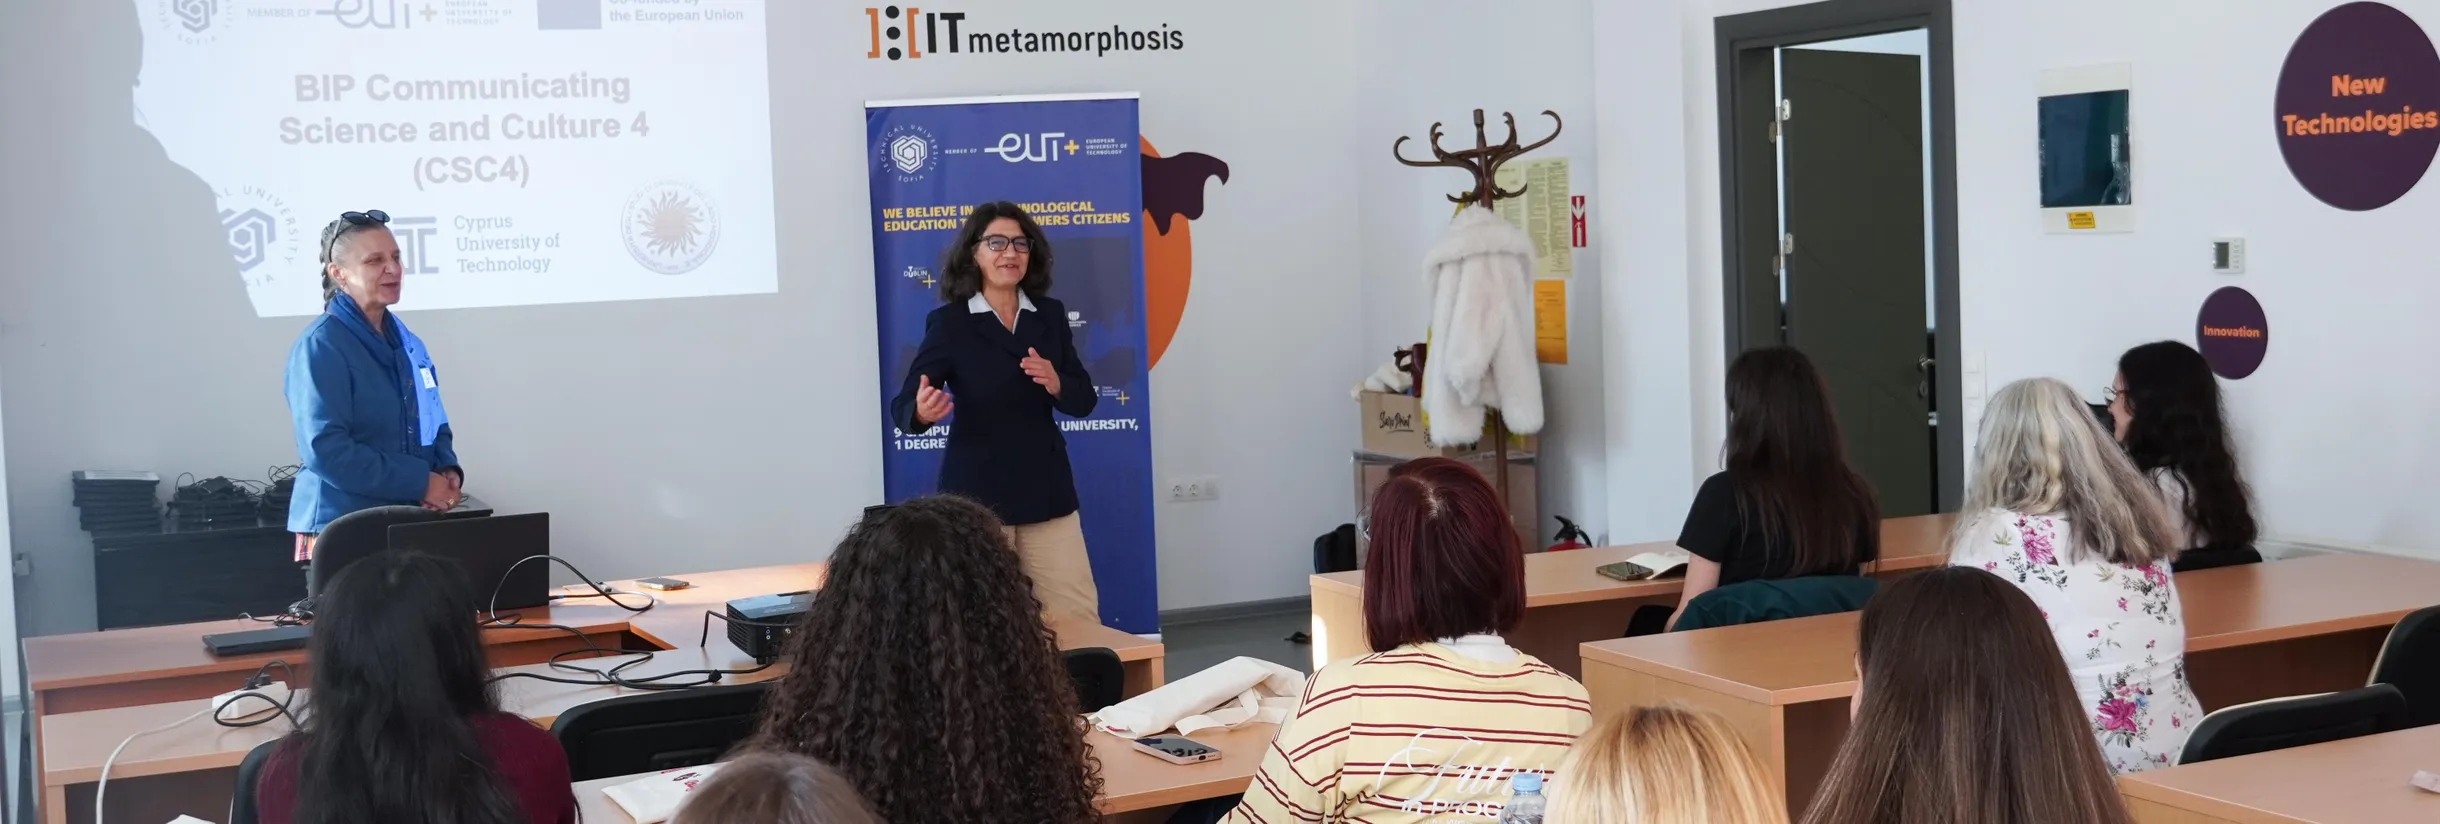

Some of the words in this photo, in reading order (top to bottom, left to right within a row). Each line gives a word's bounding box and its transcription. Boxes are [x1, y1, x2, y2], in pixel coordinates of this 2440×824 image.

[247, 8, 294, 18] MEMBER
[298, 8, 312, 18] OF
[609, 9, 631, 21] the
[635, 9, 700, 24] European
[704, 8, 744, 21] Union
[926, 12, 965, 53] IT
[969, 23, 1184, 57] metamorphosis
[295, 73, 355, 102] BIP
[366, 72, 631, 104] Communicating
[2331, 74, 2386, 97] New
[279, 115, 417, 145] Science
[428, 114, 490, 142] and
[501, 112, 621, 139] Culture
[630, 111, 650, 137] 4
[2282, 105, 2439, 137] Technologies
[413, 155, 530, 191] (CSC4)
[883, 207, 903, 219] WE
[906, 206, 957, 218] BELIEVE
[960, 205, 974, 216] IN
[1017, 201, 1095, 214] NOLOGICAL
[1072, 212, 1131, 225] CITIZENS
[454, 214, 513, 233] Cyprus
[884, 218, 957, 232] EDUCATION
[456, 233, 541, 252] University
[545, 232, 560, 248] of
[457, 255, 551, 273] Technology
[2203, 325, 2261, 339] Innovation
[1060, 418, 1139, 431] UNIVERSITY,
[894, 440, 901, 450] 1
[904, 438, 948, 450] DEGRE
[1432, 799, 1501, 818] PROG
